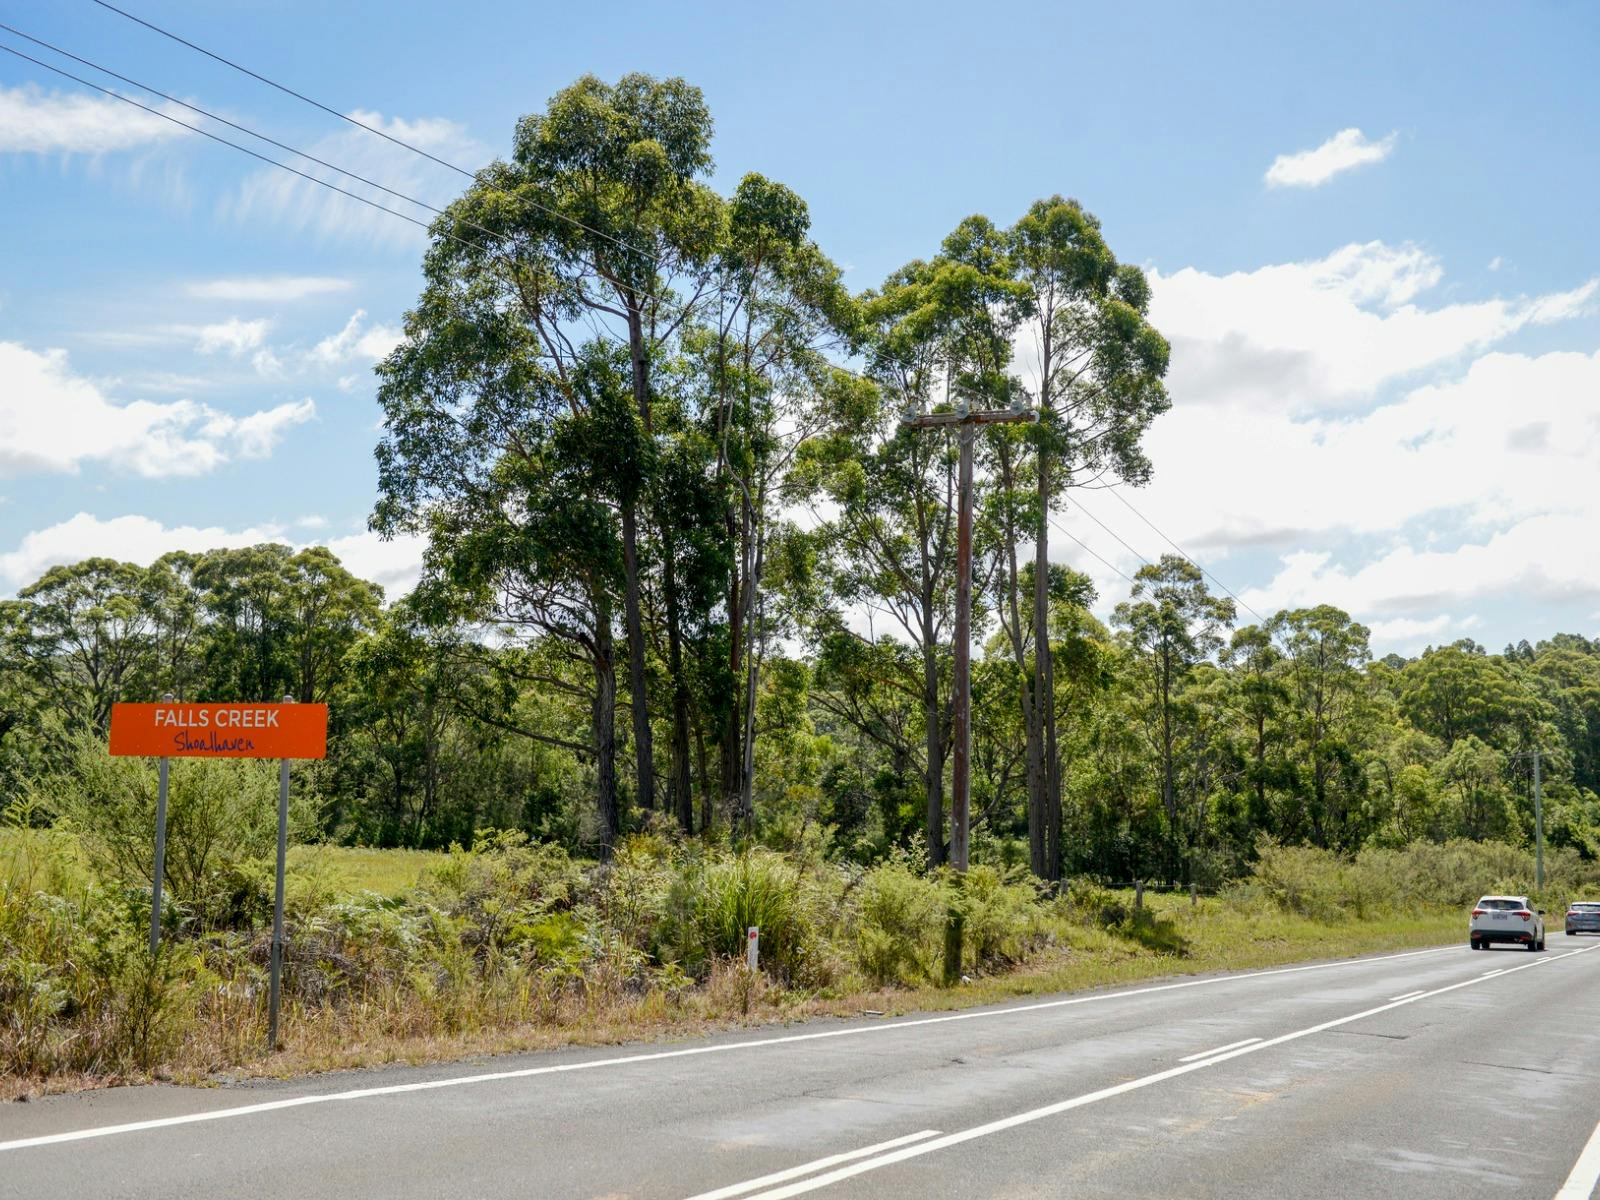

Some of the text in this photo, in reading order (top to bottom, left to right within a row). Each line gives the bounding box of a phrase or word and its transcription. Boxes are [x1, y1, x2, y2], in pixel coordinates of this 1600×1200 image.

[154, 709, 279, 728] FALLS CREEK
[173, 730, 255, 752] Shoalhaven
